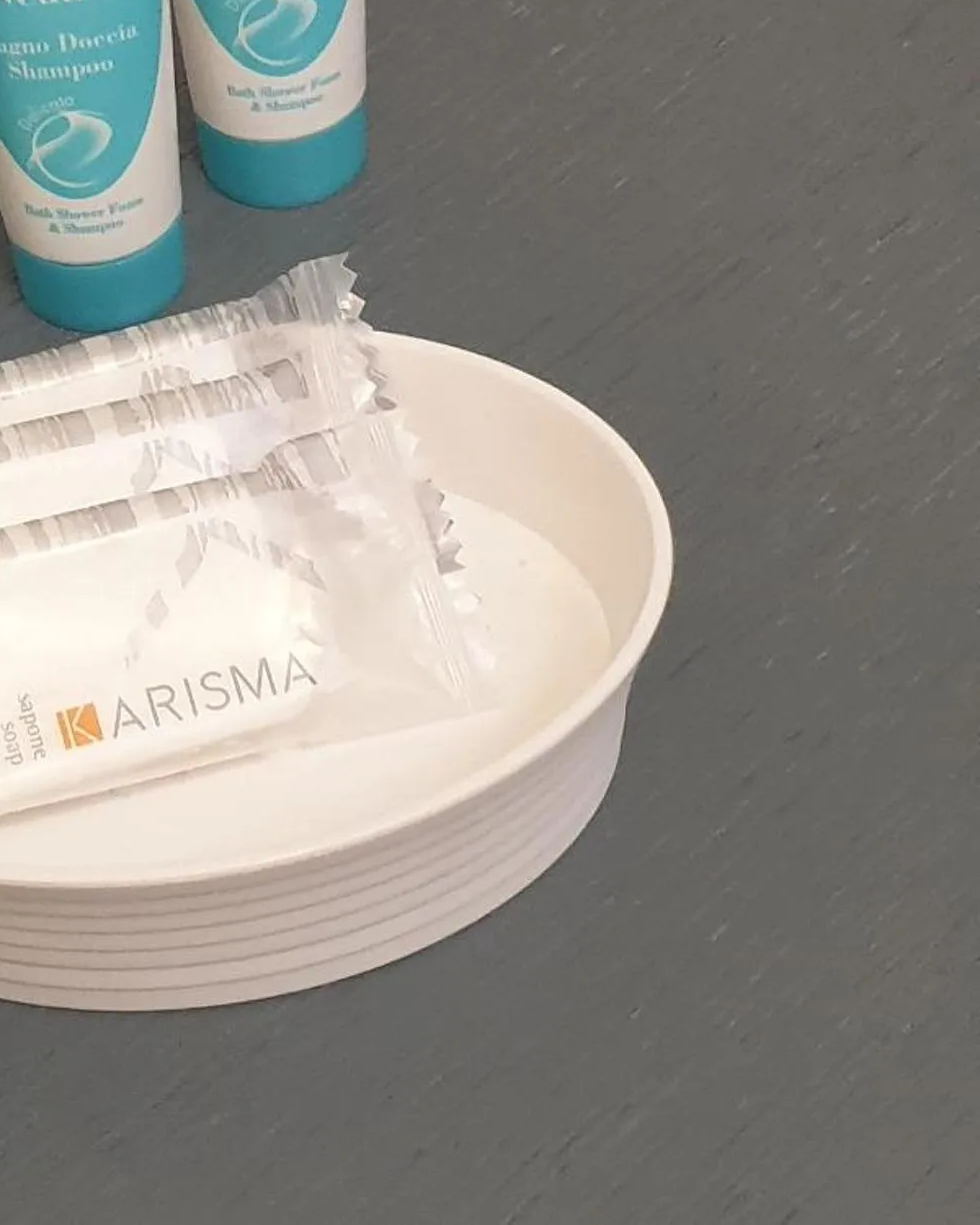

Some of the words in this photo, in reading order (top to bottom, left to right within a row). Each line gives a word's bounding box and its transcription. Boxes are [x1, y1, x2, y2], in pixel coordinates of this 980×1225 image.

[57, 23, 140, 54] Doccia
[7, 57, 115, 82] Shampoo
[56, 651, 318, 751] KARISMA
[1, 720, 24, 766] soap
[18, 692, 46, 761] sapone
